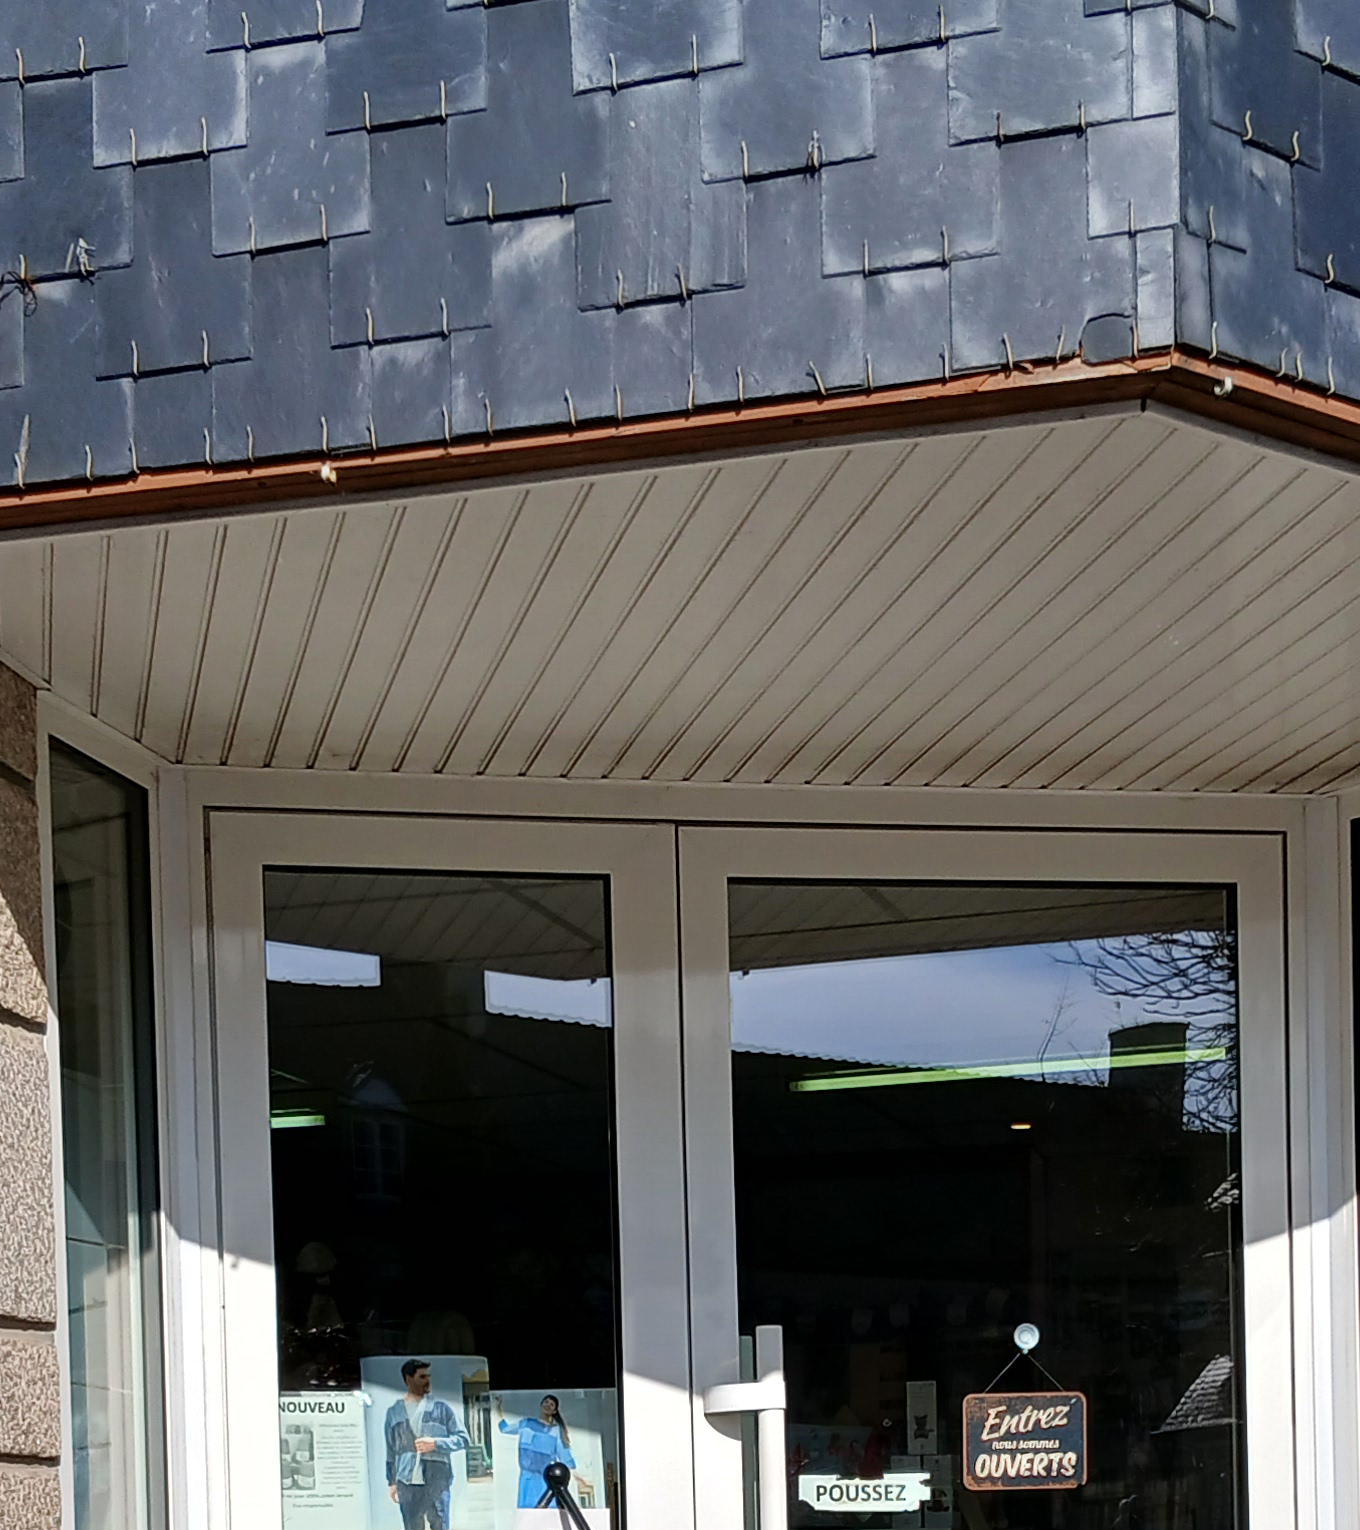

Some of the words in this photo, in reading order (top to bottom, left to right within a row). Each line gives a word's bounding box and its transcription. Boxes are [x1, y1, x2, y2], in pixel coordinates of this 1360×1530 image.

[278, 1402, 345, 1413] NOUVEAU
[981, 1405, 1070, 1440] Entrez
[992, 1440, 1016, 1450] nous
[1018, 1439, 1059, 1449] sommes
[975, 1452, 1077, 1478] OUVERTS
[816, 1484, 907, 1502] POUSSEZ
